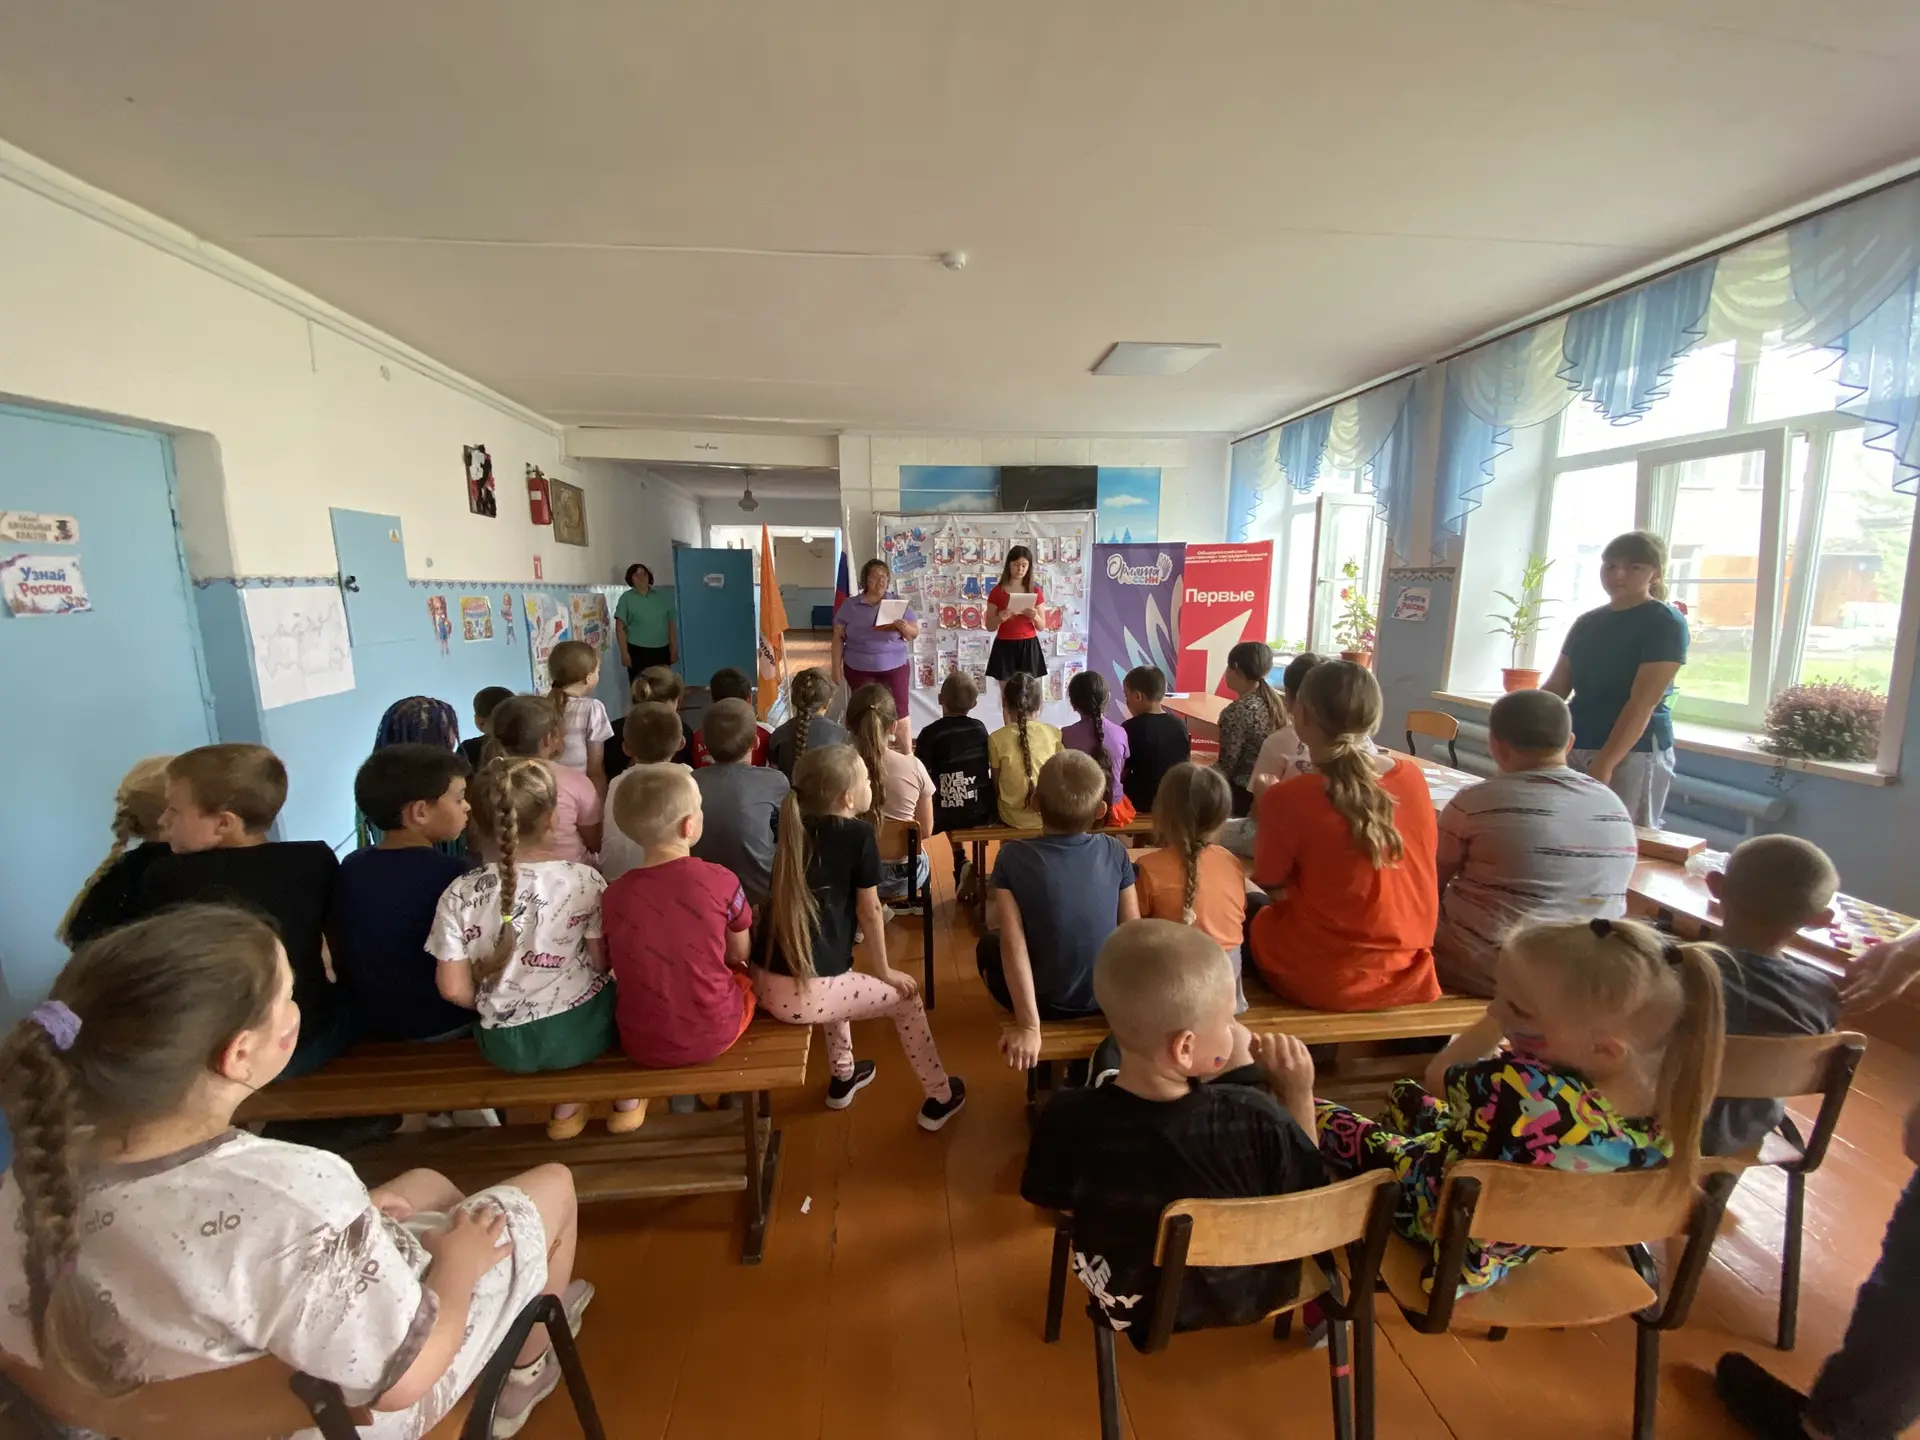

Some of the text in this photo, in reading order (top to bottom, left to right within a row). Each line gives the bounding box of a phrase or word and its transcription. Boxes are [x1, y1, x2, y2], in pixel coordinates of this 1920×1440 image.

[20, 566, 66, 581] Узнай
[19, 582, 73, 597] Россию
[1185, 588, 1256, 607] Первые
[939, 771, 964, 781] GIVE
[940, 775, 977, 789] EVERY
[940, 785, 967, 797] MAN
[941, 800, 965, 808] EAR
[86, 1209, 115, 1233] alo
[201, 1210, 241, 1237] alo
[355, 1259, 380, 1294] alo
